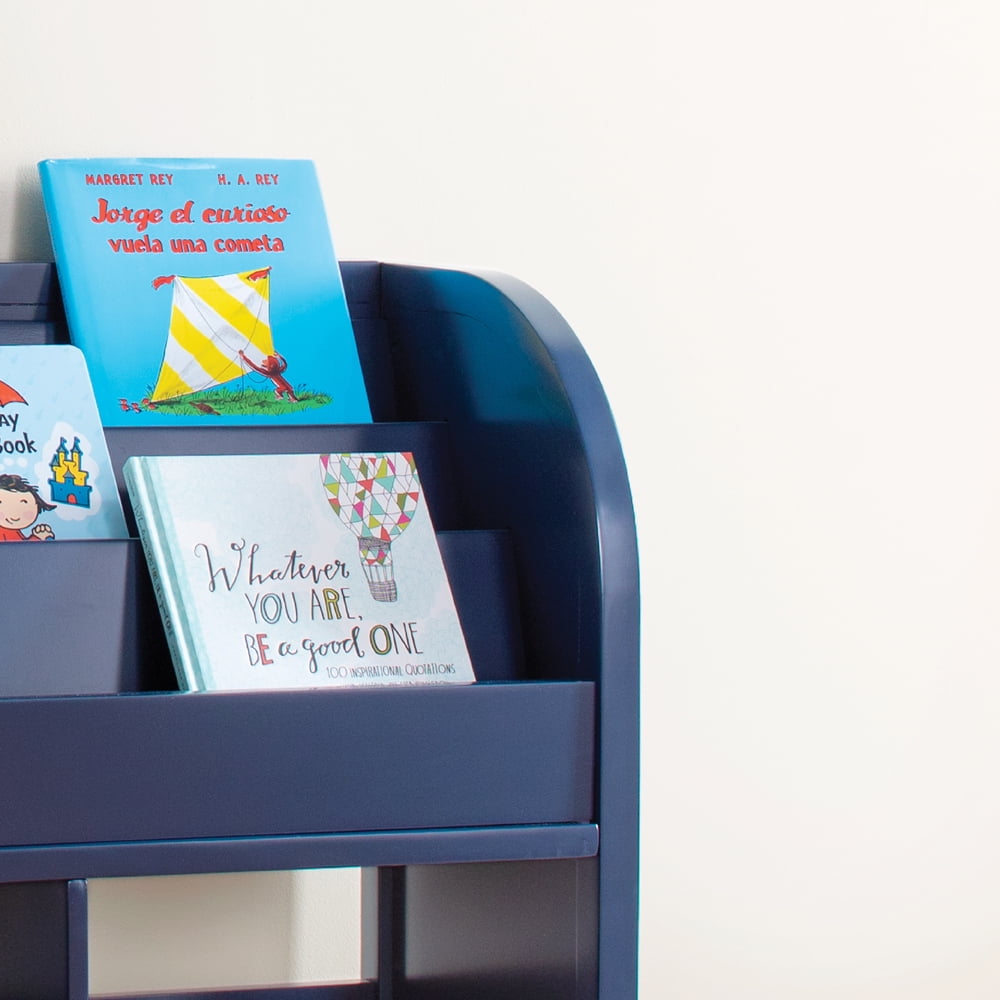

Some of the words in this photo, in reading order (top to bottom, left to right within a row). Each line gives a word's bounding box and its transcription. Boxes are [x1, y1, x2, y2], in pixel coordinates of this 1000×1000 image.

[85, 173, 144, 186] MARGRET
[149, 173, 174, 185] REY
[217, 173, 232, 185] H.
[237, 173, 250, 185] A.
[255, 173, 279, 185] REY
[91, 197, 164, 232] Jorge
[169, 200, 195, 224] el
[201, 203, 291, 224] curioso
[107, 233, 164, 253] vuela
[169, 238, 208, 253] una
[213, 233, 285, 253] cometa
[194, 538, 350, 592] Whatever
[245, 592, 298, 625] YOU
[310, 587, 363, 623] ARE,
[244, 633, 274, 667] BE
[278, 639, 298, 656] a
[301, 623, 365, 674] good
[368, 621, 424, 656] ONE
[326, 666, 348, 679] 100
[350, 664, 403, 679] INSPIRATIONAL
[405, 663, 456, 677] QUOTATIONS
